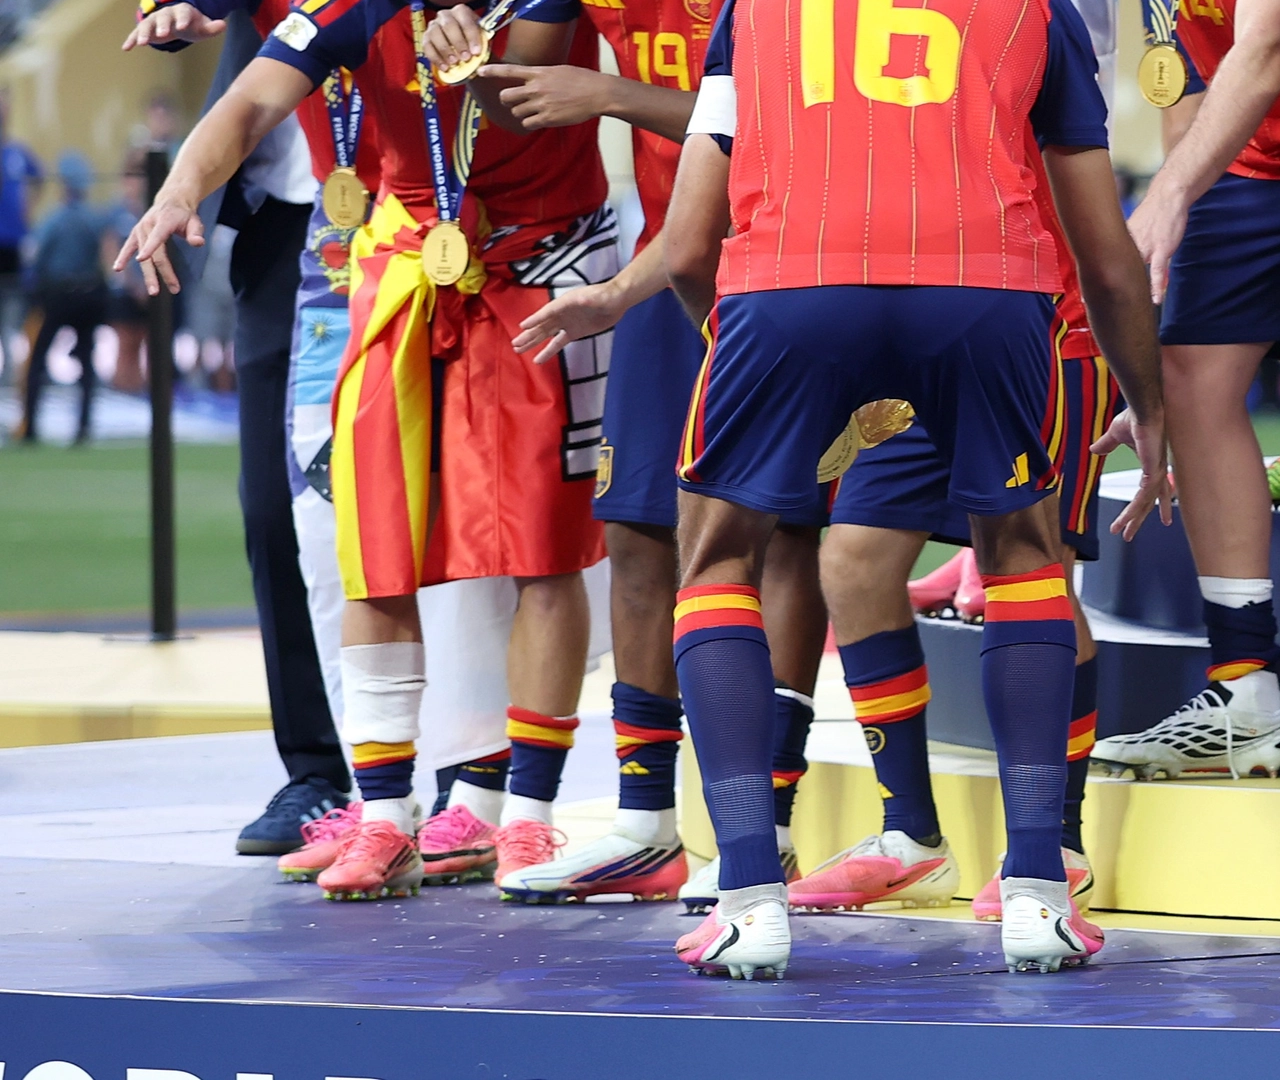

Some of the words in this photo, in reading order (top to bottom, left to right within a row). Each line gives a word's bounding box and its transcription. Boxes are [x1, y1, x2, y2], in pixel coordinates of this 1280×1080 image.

[633, 32, 691, 92] 19
[333, 117, 345, 141] FIFA
[428, 118, 440, 142] FIFA
[431, 142, 446, 188] WORLD
[437, 188, 449, 210] CUP
